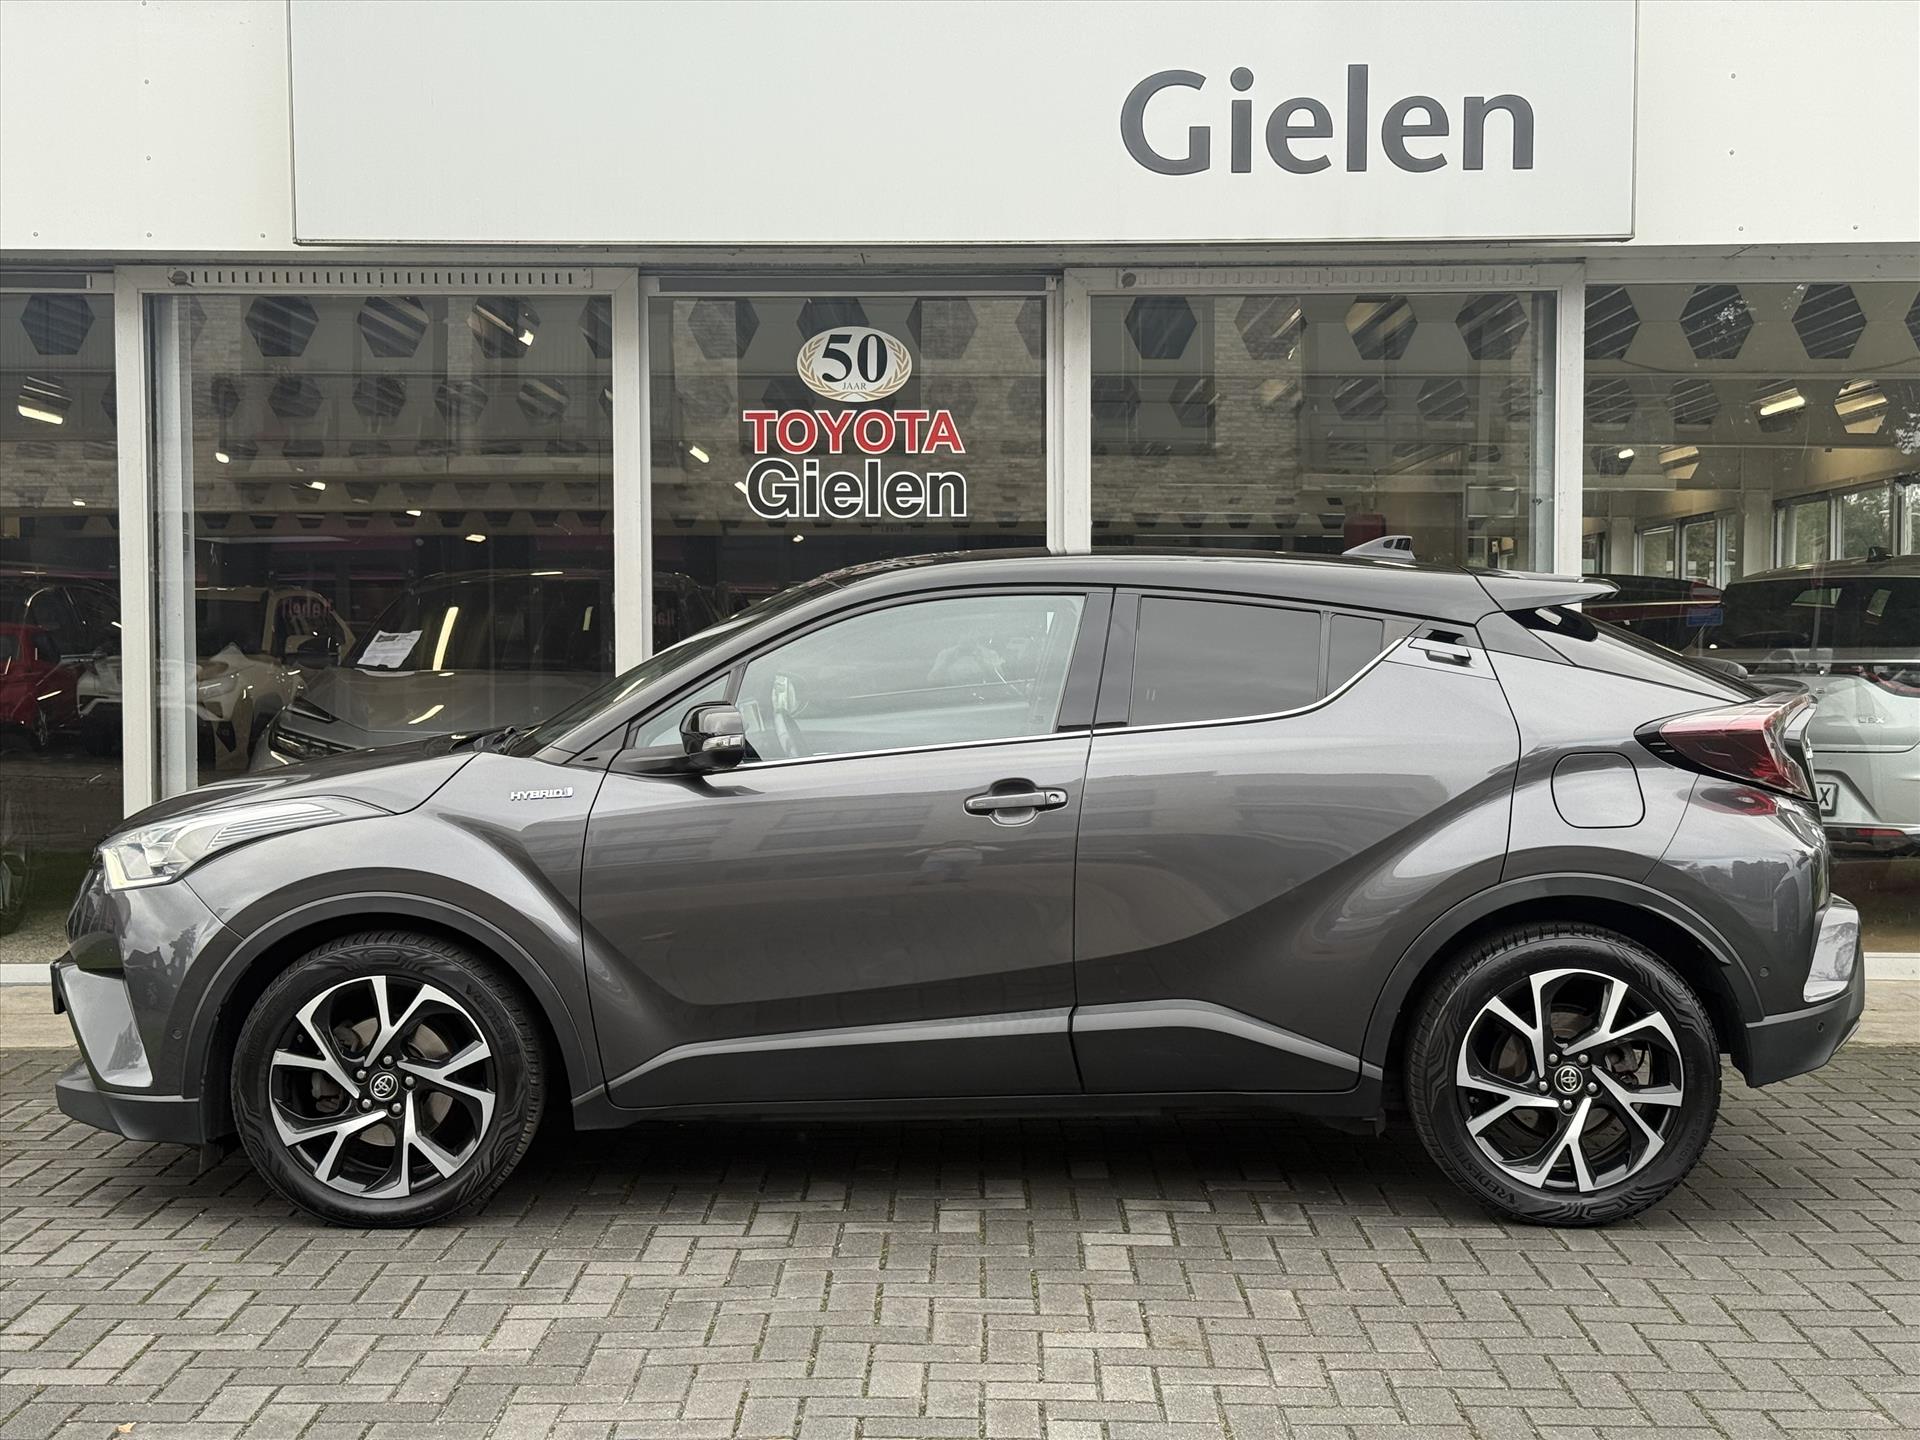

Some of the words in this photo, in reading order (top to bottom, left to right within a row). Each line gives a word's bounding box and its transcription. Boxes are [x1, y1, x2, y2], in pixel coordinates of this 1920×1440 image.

[1120, 64, 1534, 175] Gielen
[821, 333, 888, 383] 50
[842, 382, 867, 391] JAAR
[743, 409, 966, 454] TOYOTA
[745, 457, 967, 519] Gielen
[510, 789, 563, 801] HYBRID
